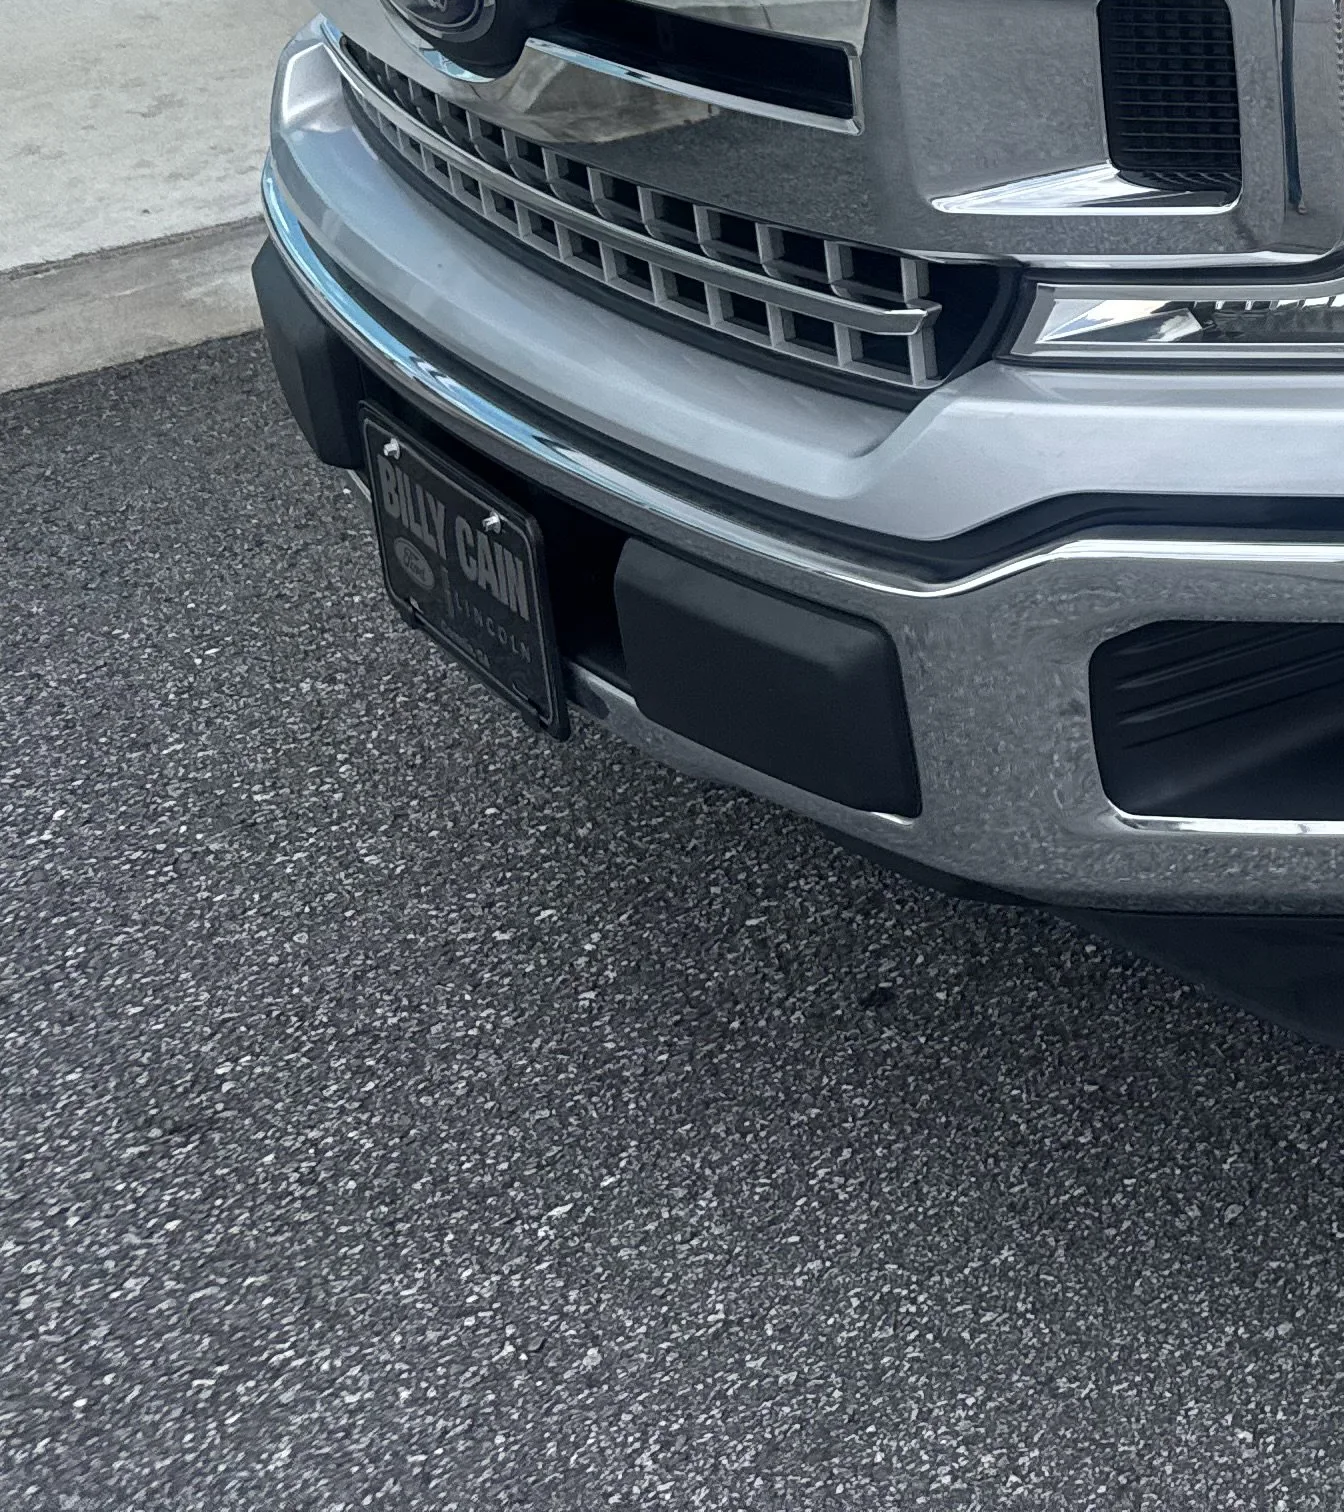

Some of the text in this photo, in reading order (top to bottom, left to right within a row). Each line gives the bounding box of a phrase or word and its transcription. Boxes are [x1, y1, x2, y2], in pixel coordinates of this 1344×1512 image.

[376, 454, 530, 622] BILLY CAIN
[453, 592, 532, 664] LINCOLN
